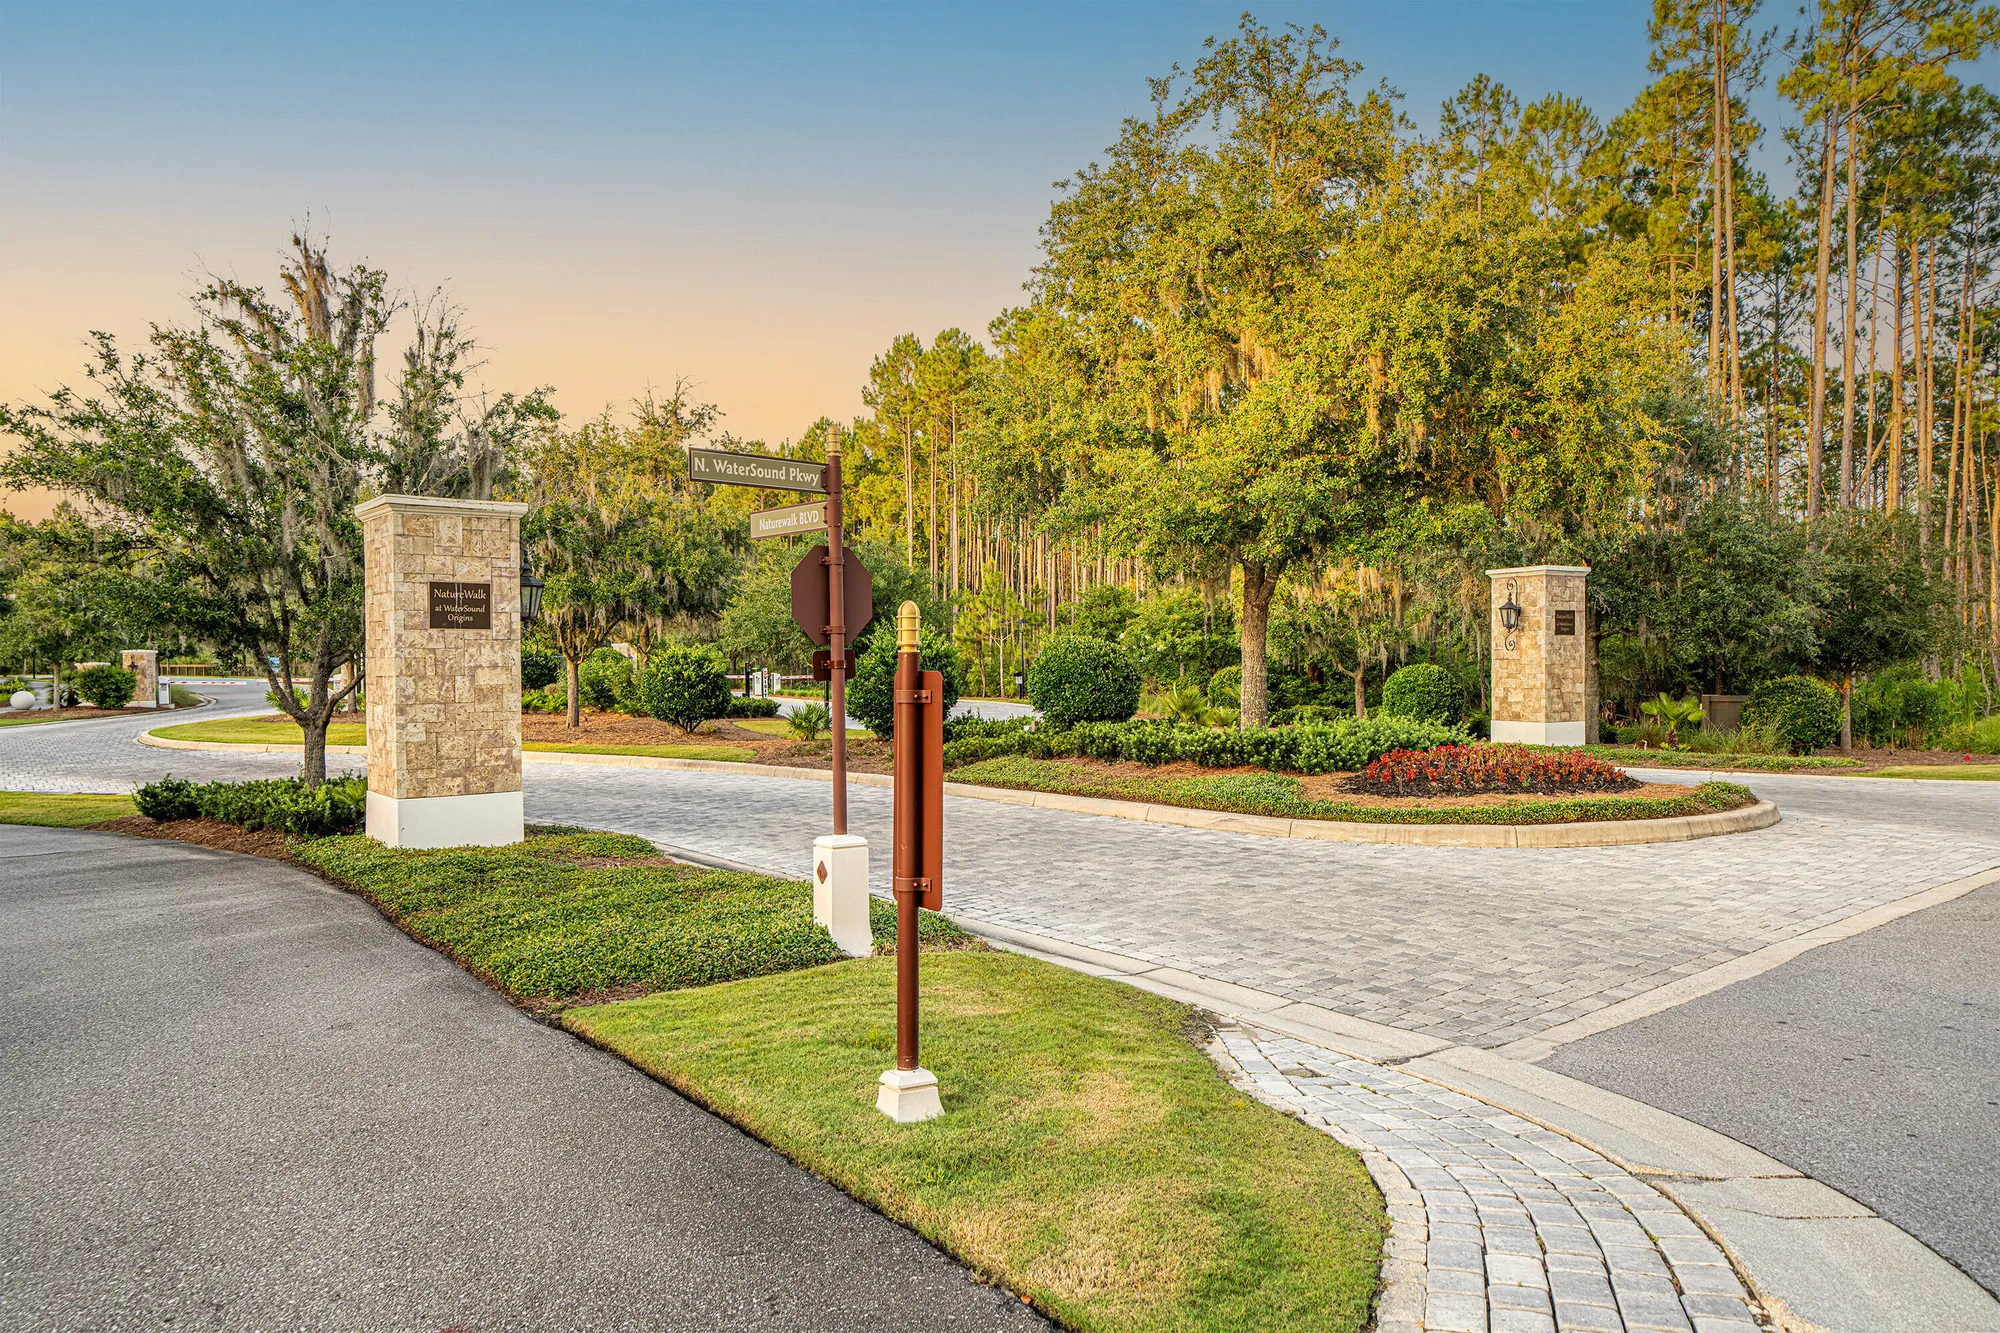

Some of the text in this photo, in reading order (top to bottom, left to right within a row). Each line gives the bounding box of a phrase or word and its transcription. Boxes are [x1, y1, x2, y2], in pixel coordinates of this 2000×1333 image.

[694, 457, 819, 486] N. WaterSound Pkwy
[759, 510, 819, 531] Naturewalk BLVD
[433, 588, 487, 600] NatureWalk
[434, 604, 486, 613] at WaterSound
[447, 613, 474, 624] Origins
